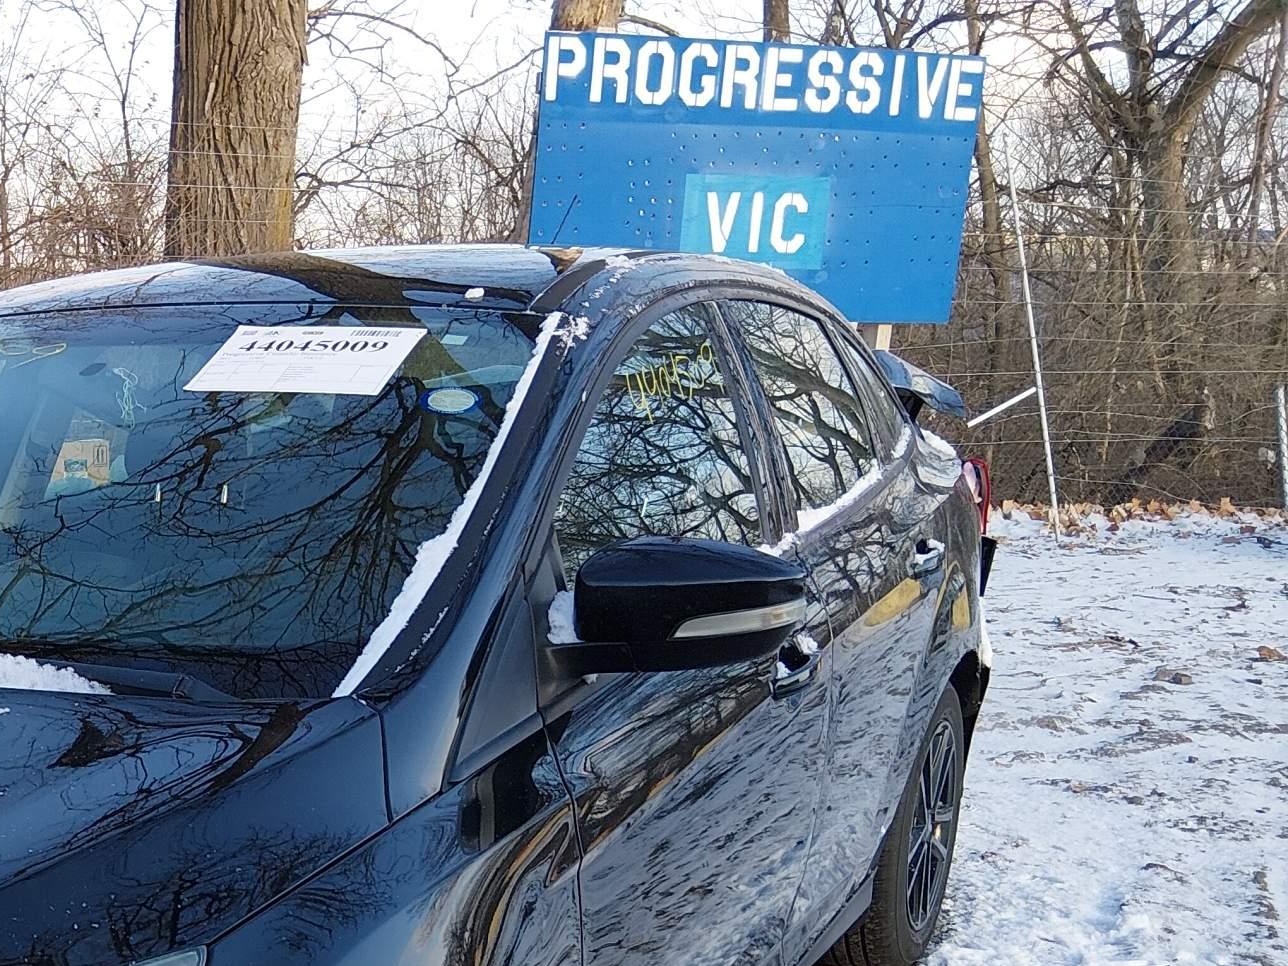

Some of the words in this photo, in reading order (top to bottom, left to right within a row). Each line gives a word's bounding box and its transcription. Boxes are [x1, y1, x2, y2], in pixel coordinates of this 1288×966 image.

[544, 35, 985, 122] PROGRESSIVE
[706, 190, 810, 255] VIC
[239, 340, 389, 353] 44045009
